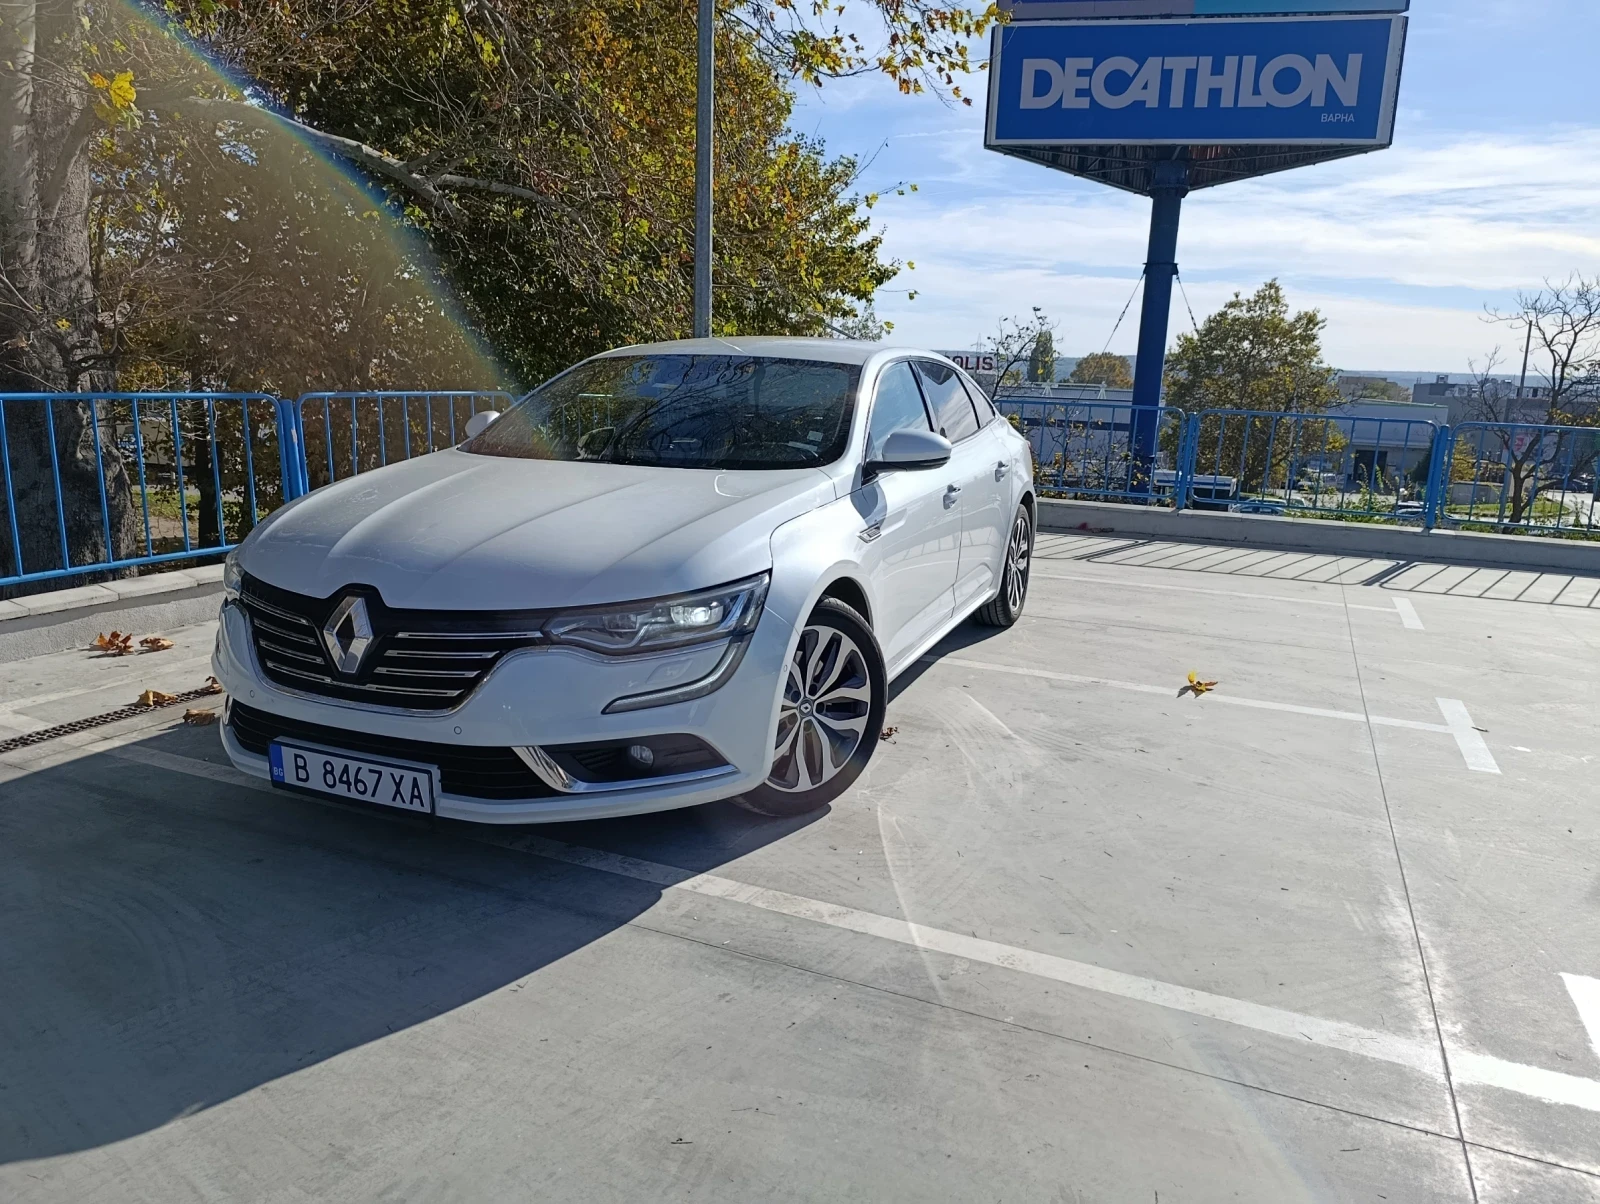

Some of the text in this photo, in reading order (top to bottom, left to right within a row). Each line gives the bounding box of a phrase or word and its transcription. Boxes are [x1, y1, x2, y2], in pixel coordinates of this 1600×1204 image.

[1019, 53, 1363, 110] DECATHLON
[945, 355, 993, 371] OLIS
[273, 766, 284, 777] BG
[294, 752, 425, 808] B 8467 XA
